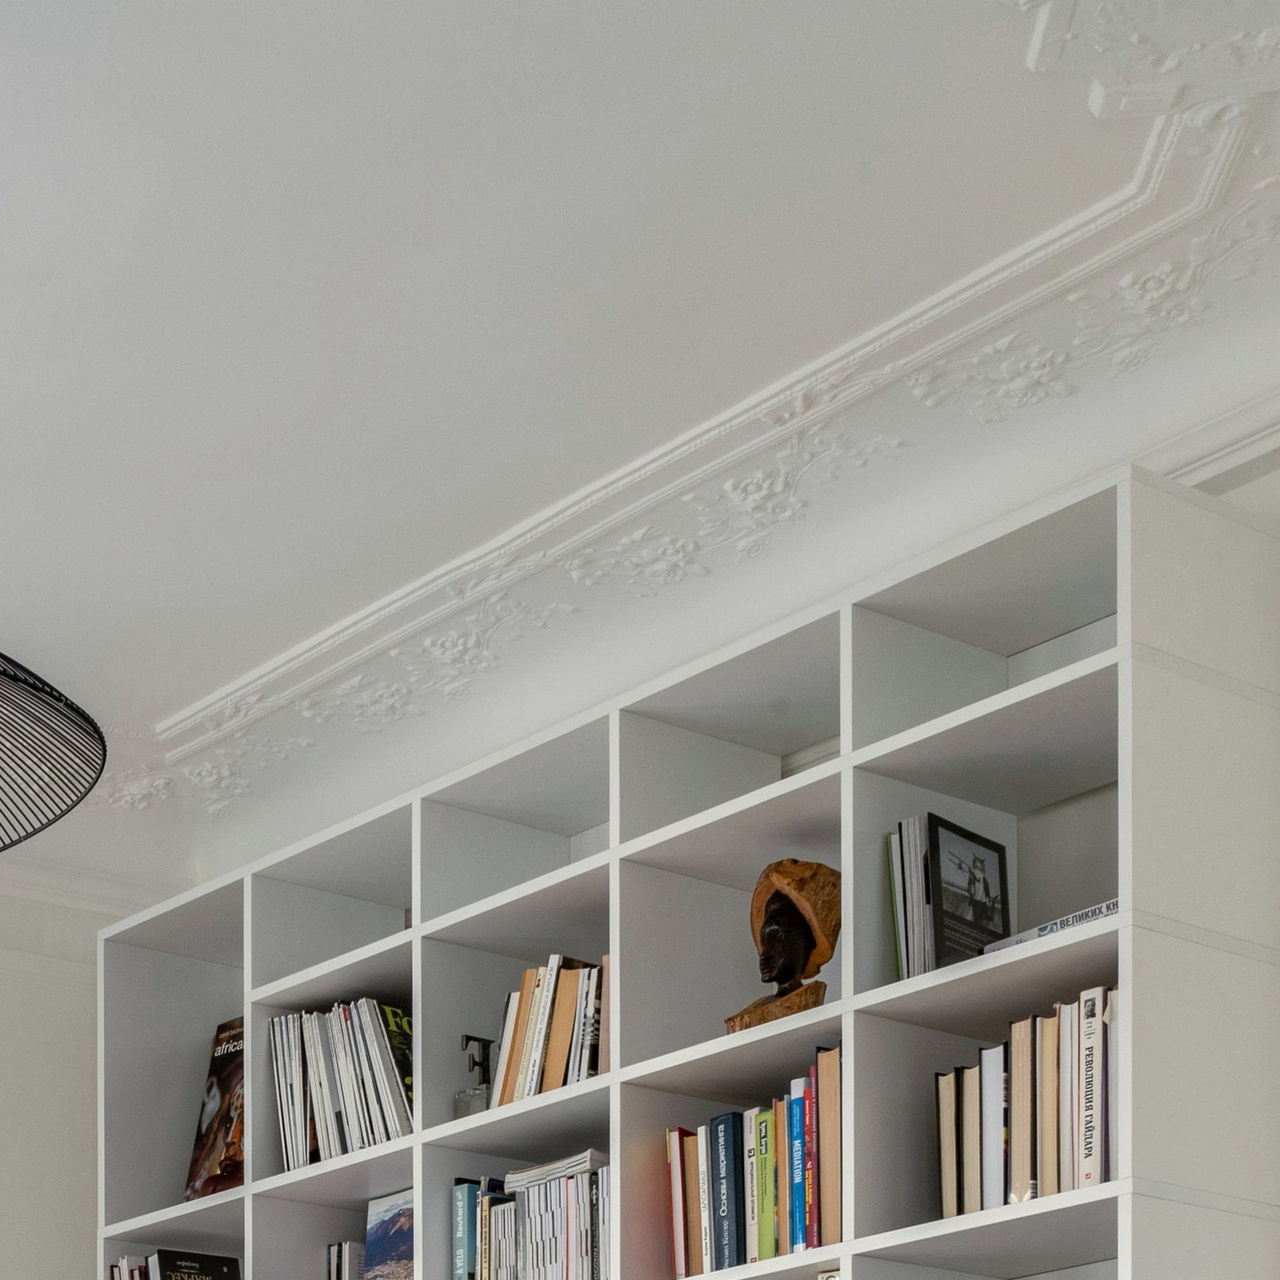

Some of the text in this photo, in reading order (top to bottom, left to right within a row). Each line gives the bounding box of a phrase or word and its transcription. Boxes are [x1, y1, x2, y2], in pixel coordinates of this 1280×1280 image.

[1059, 908, 1104, 930] ВЕЛИКИХ
[1083, 1046, 1097, 1160] РЕВОЛЮЦИЯ ГАЙДАРА
[717, 1124, 728, 1217] Основы маркетинга
[793, 1139, 803, 1184] MEDIATION
[456, 1201, 464, 1238] Routard
[454, 1248, 464, 1268] VÉLO
